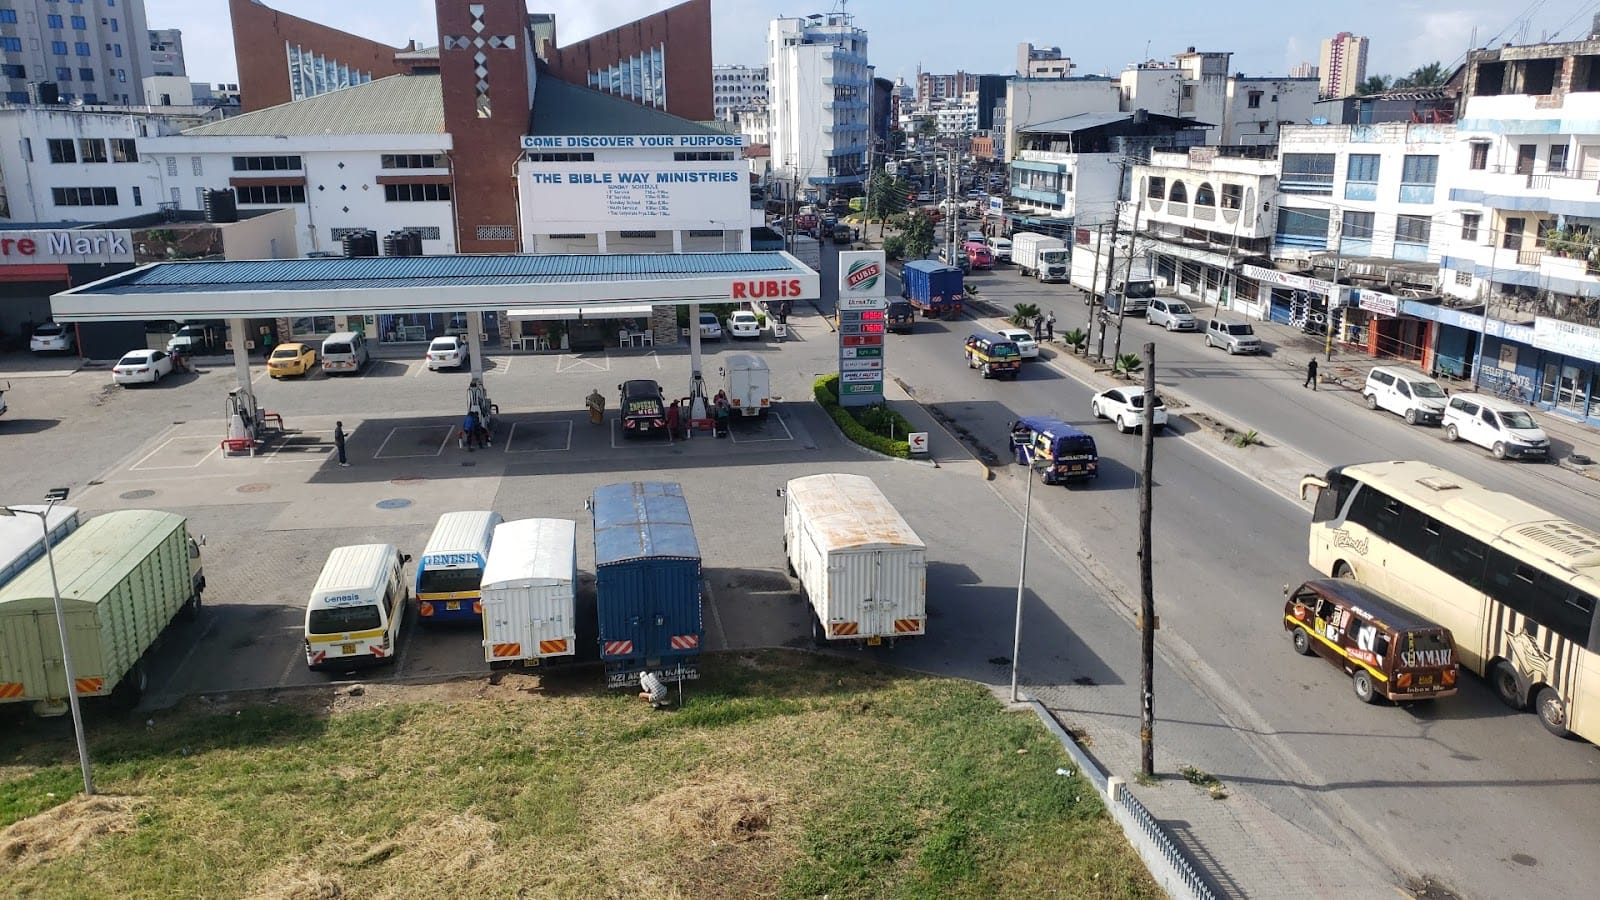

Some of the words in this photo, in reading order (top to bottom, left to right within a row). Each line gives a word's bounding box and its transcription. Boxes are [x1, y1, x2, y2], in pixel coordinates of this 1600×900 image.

[524, 137, 563, 147] COME
[567, 136, 634, 147] DISCOVER
[640, 136, 673, 146] YOUR
[680, 135, 743, 146] PURPOSE
[532, 173, 562, 184] THE
[569, 172, 613, 184] BIBLE
[617, 172, 650, 183] WAY
[656, 171, 739, 183] MINISTRIES
[1, 236, 36, 256] re
[48, 231, 127, 255] Mark
[1459, 314, 1499, 336] PEGER
[1482, 364, 1504, 378] PEGLER
[424, 553, 479, 566] GENESIS
[324, 593, 360, 603] Genesis
